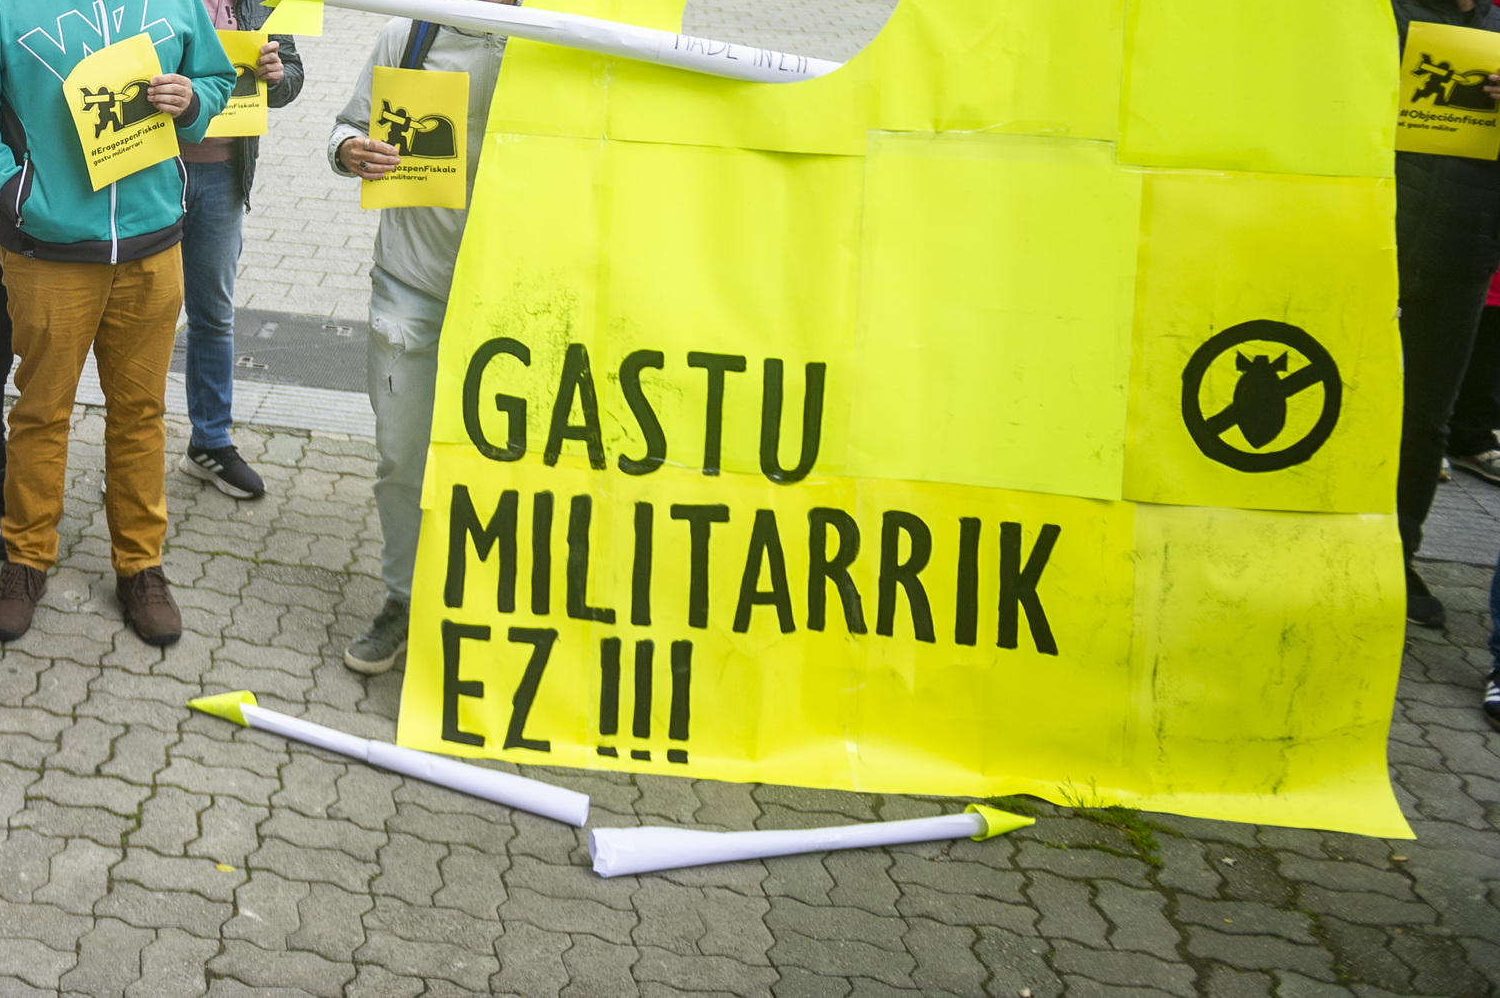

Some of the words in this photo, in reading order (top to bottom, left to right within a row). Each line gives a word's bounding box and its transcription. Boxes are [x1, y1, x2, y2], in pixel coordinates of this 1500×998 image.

[753, 47, 773, 69] IN
[1399, 110, 1497, 127] #Objeciónfiscal
[91, 121, 166, 157] #EragozpenFiskala
[93, 154, 112, 167] gastu
[112, 139, 143, 158] militarrari
[462, 337, 827, 485] GASTU
[443, 484, 1062, 657] MILITARRIK
[441, 618, 559, 753] EZ
[596, 636, 693, 764] !!!
